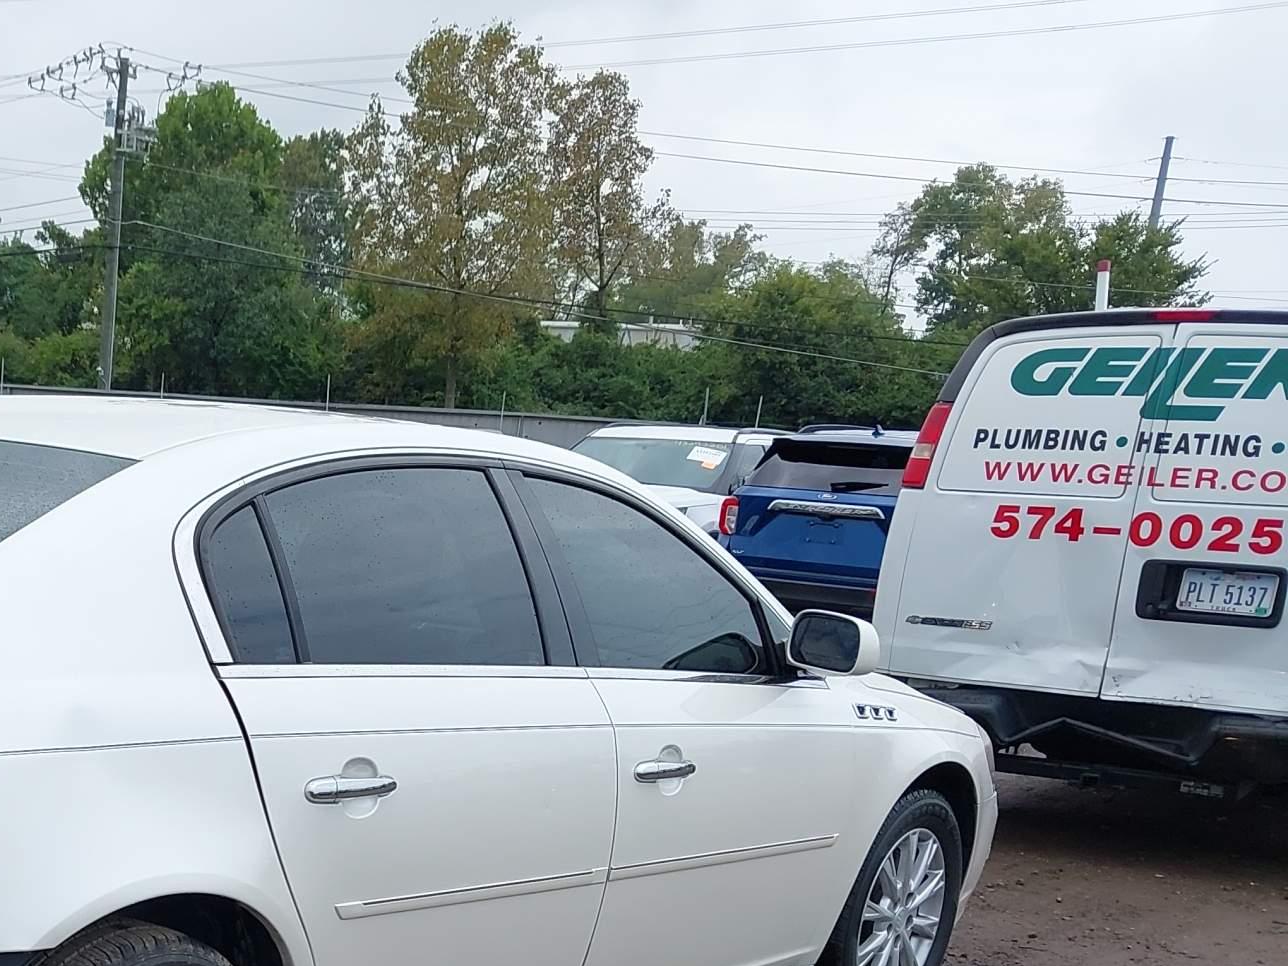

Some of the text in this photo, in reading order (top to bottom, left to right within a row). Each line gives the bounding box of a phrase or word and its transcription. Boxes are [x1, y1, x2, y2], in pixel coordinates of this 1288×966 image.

[973, 428, 1262, 458] PLUMBING HEATING
[990, 504, 1284, 555] 574-0025
[1185, 581, 1269, 609] PLT 5137
